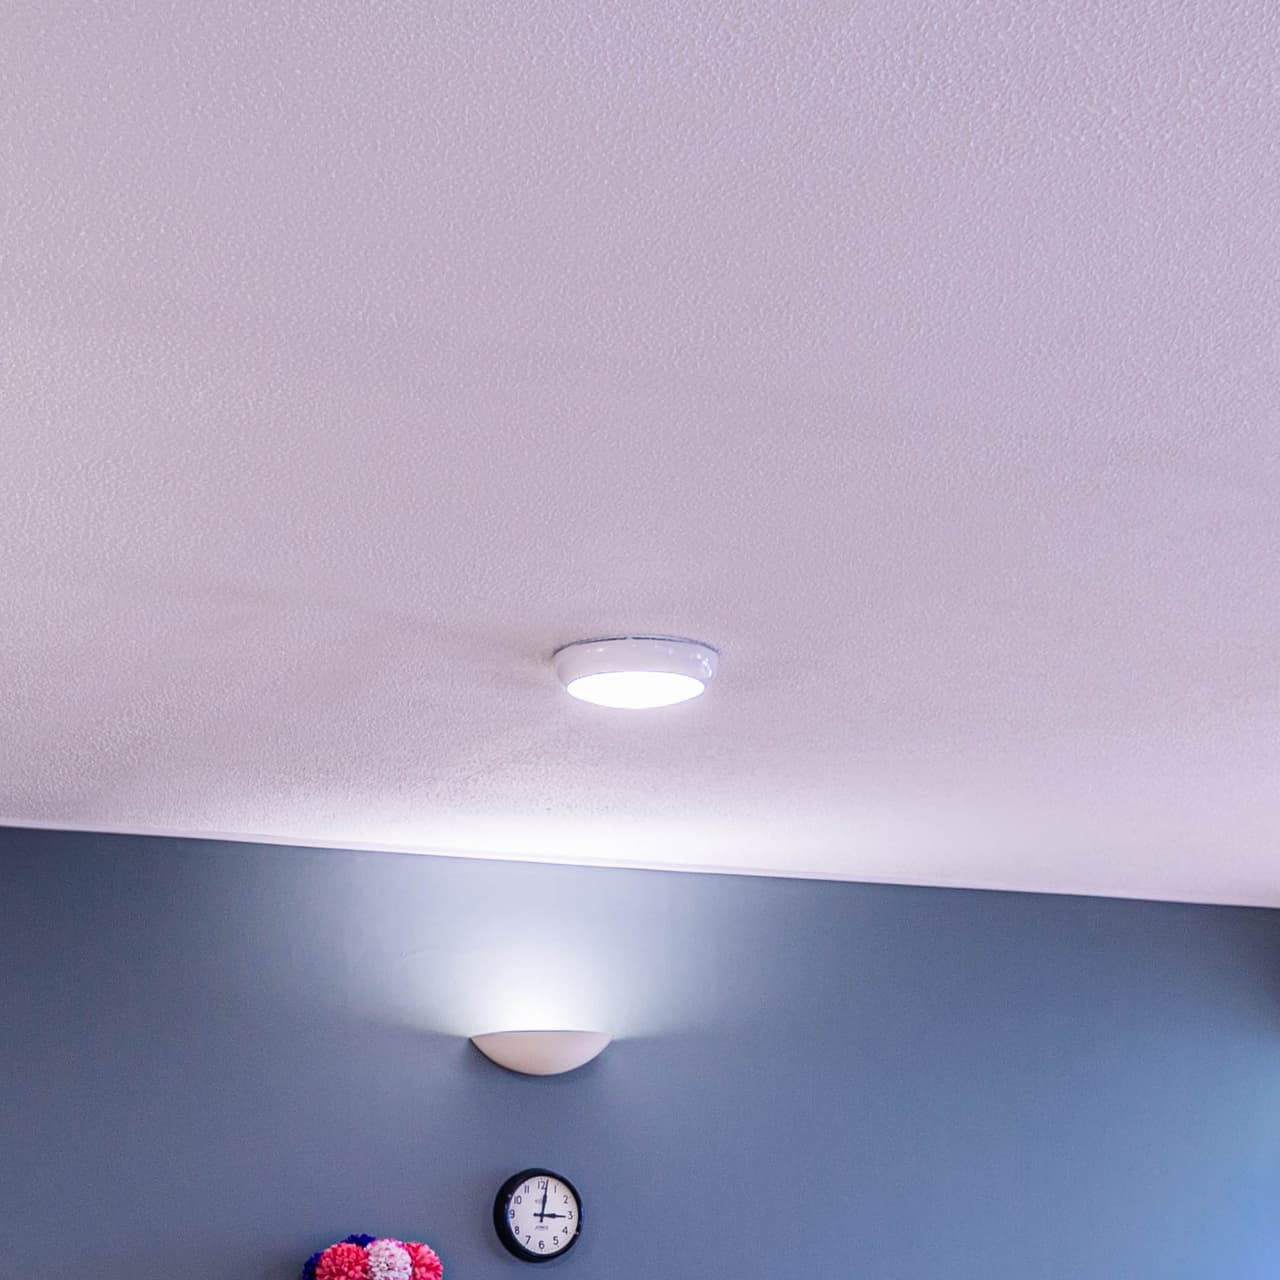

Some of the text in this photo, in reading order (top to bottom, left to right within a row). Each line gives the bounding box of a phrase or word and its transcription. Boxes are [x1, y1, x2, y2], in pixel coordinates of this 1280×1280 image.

[524, 1184, 530, 1194] 11
[537, 1180, 546, 1191] 12
[513, 1195, 522, 1205] 10
[563, 1195, 569, 1204] 2
[509, 1209, 516, 1219] 9
[567, 1210, 574, 1220] 3
[514, 1225, 520, 1235] 8
[562, 1226, 568, 1235] 4
[525, 1235, 531, 1244] 7
[552, 1235, 559, 1245] 5
[538, 1240, 545, 1250] 6
